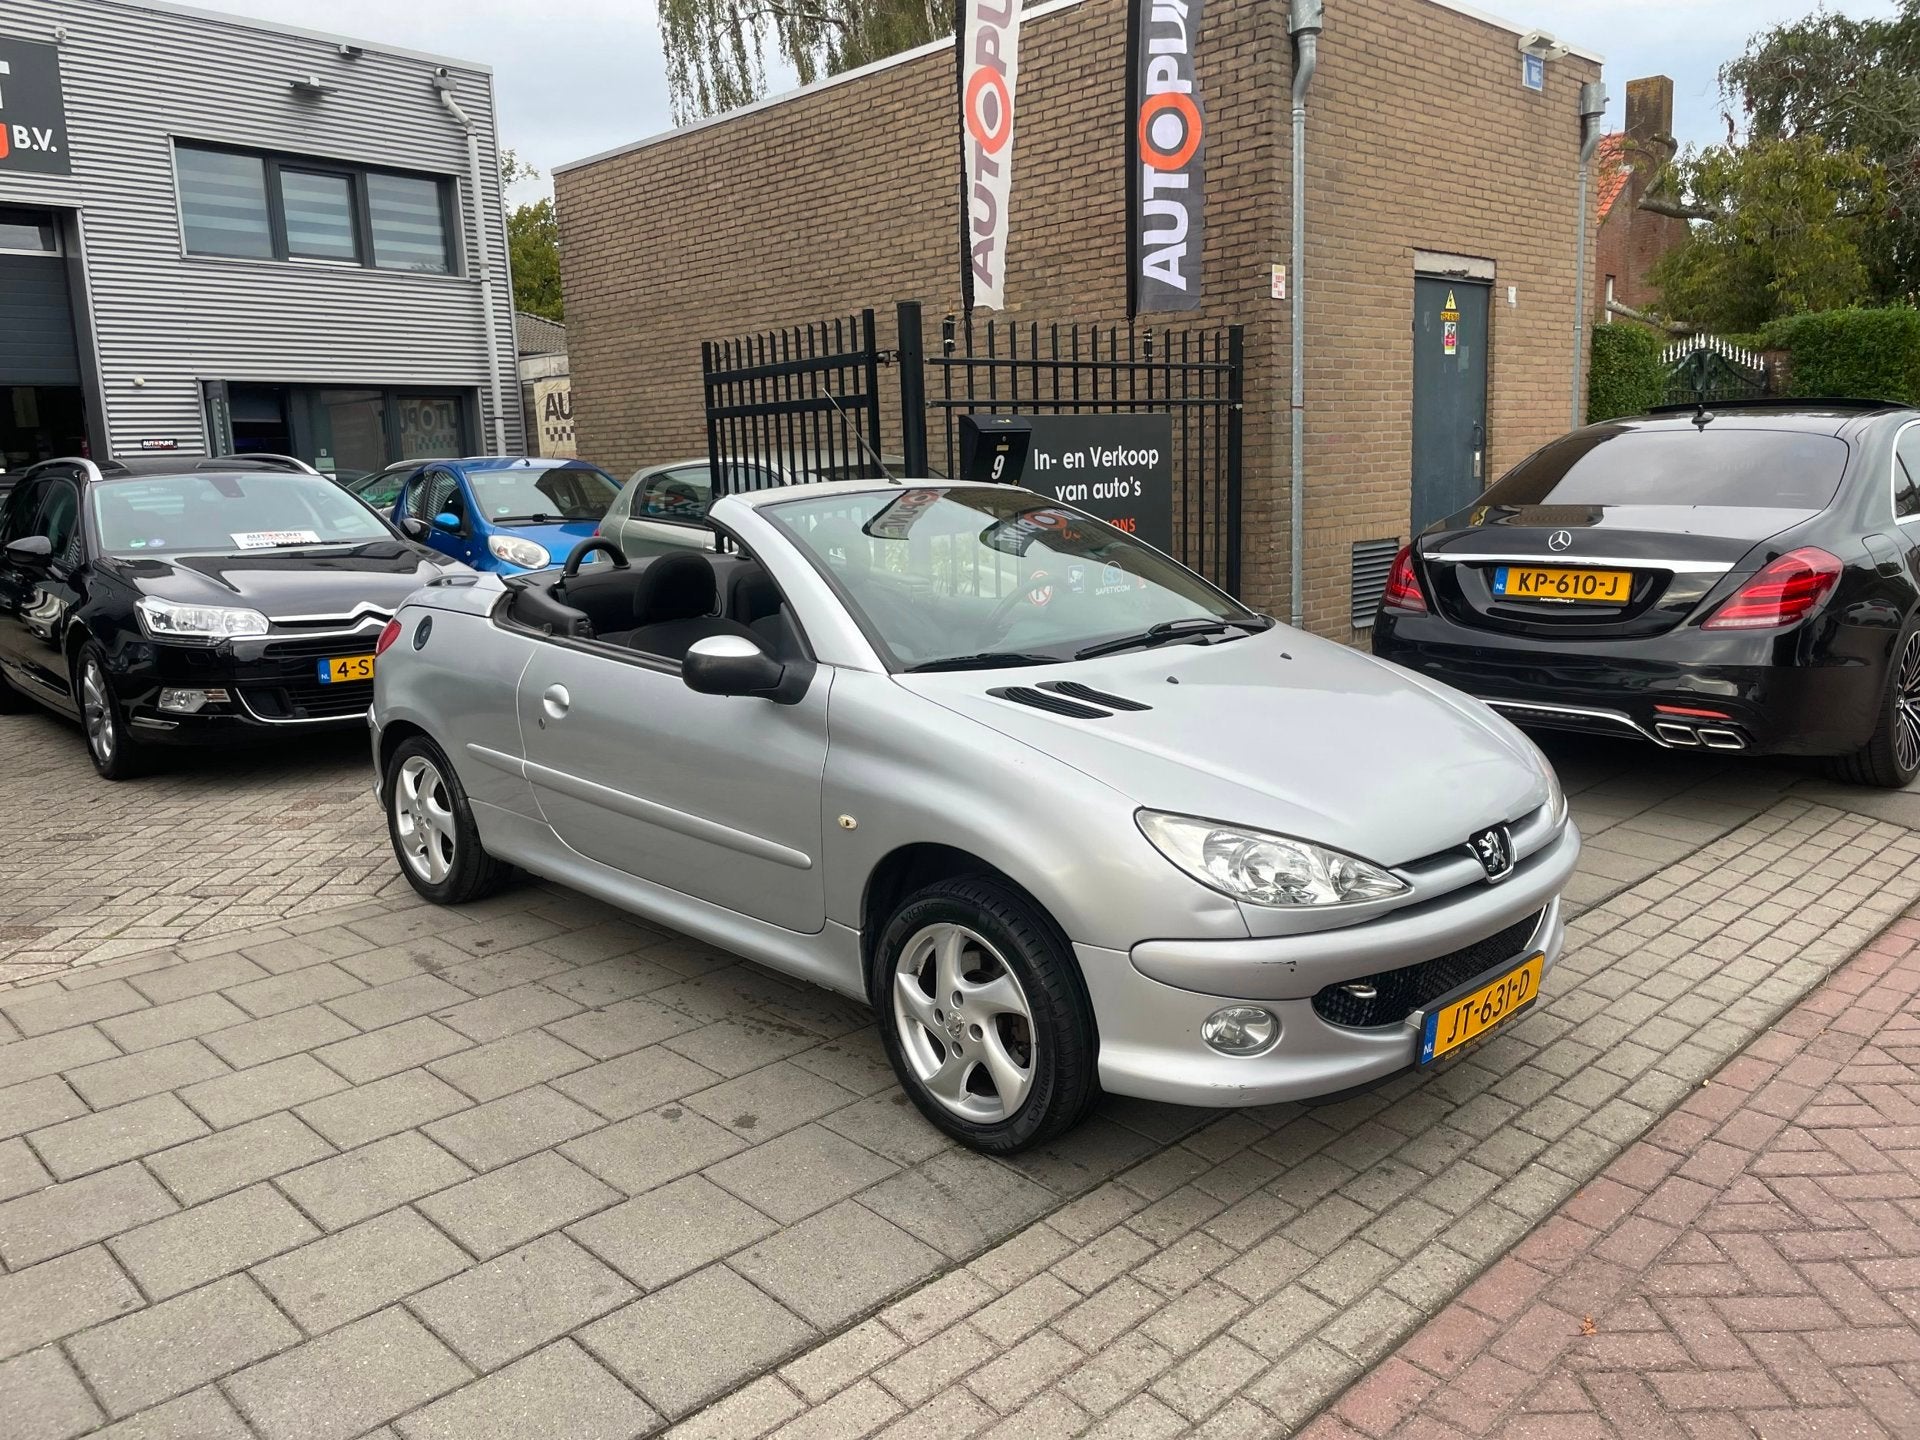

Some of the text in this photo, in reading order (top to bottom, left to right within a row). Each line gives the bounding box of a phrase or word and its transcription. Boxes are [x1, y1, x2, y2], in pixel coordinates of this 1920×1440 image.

[12, 124, 58, 153] B.V.
[545, 391, 574, 421] AU
[991, 454, 1005, 480] 9
[1033, 445, 1159, 470] In- en Verkoop
[1055, 476, 1142, 501] van auto's
[1518, 572, 1619, 597] KP-610-J
[337, 659, 375, 677] 4-S
[1423, 1042, 1433, 1055] NL
[1446, 968, 1530, 1044] JT-631-D
